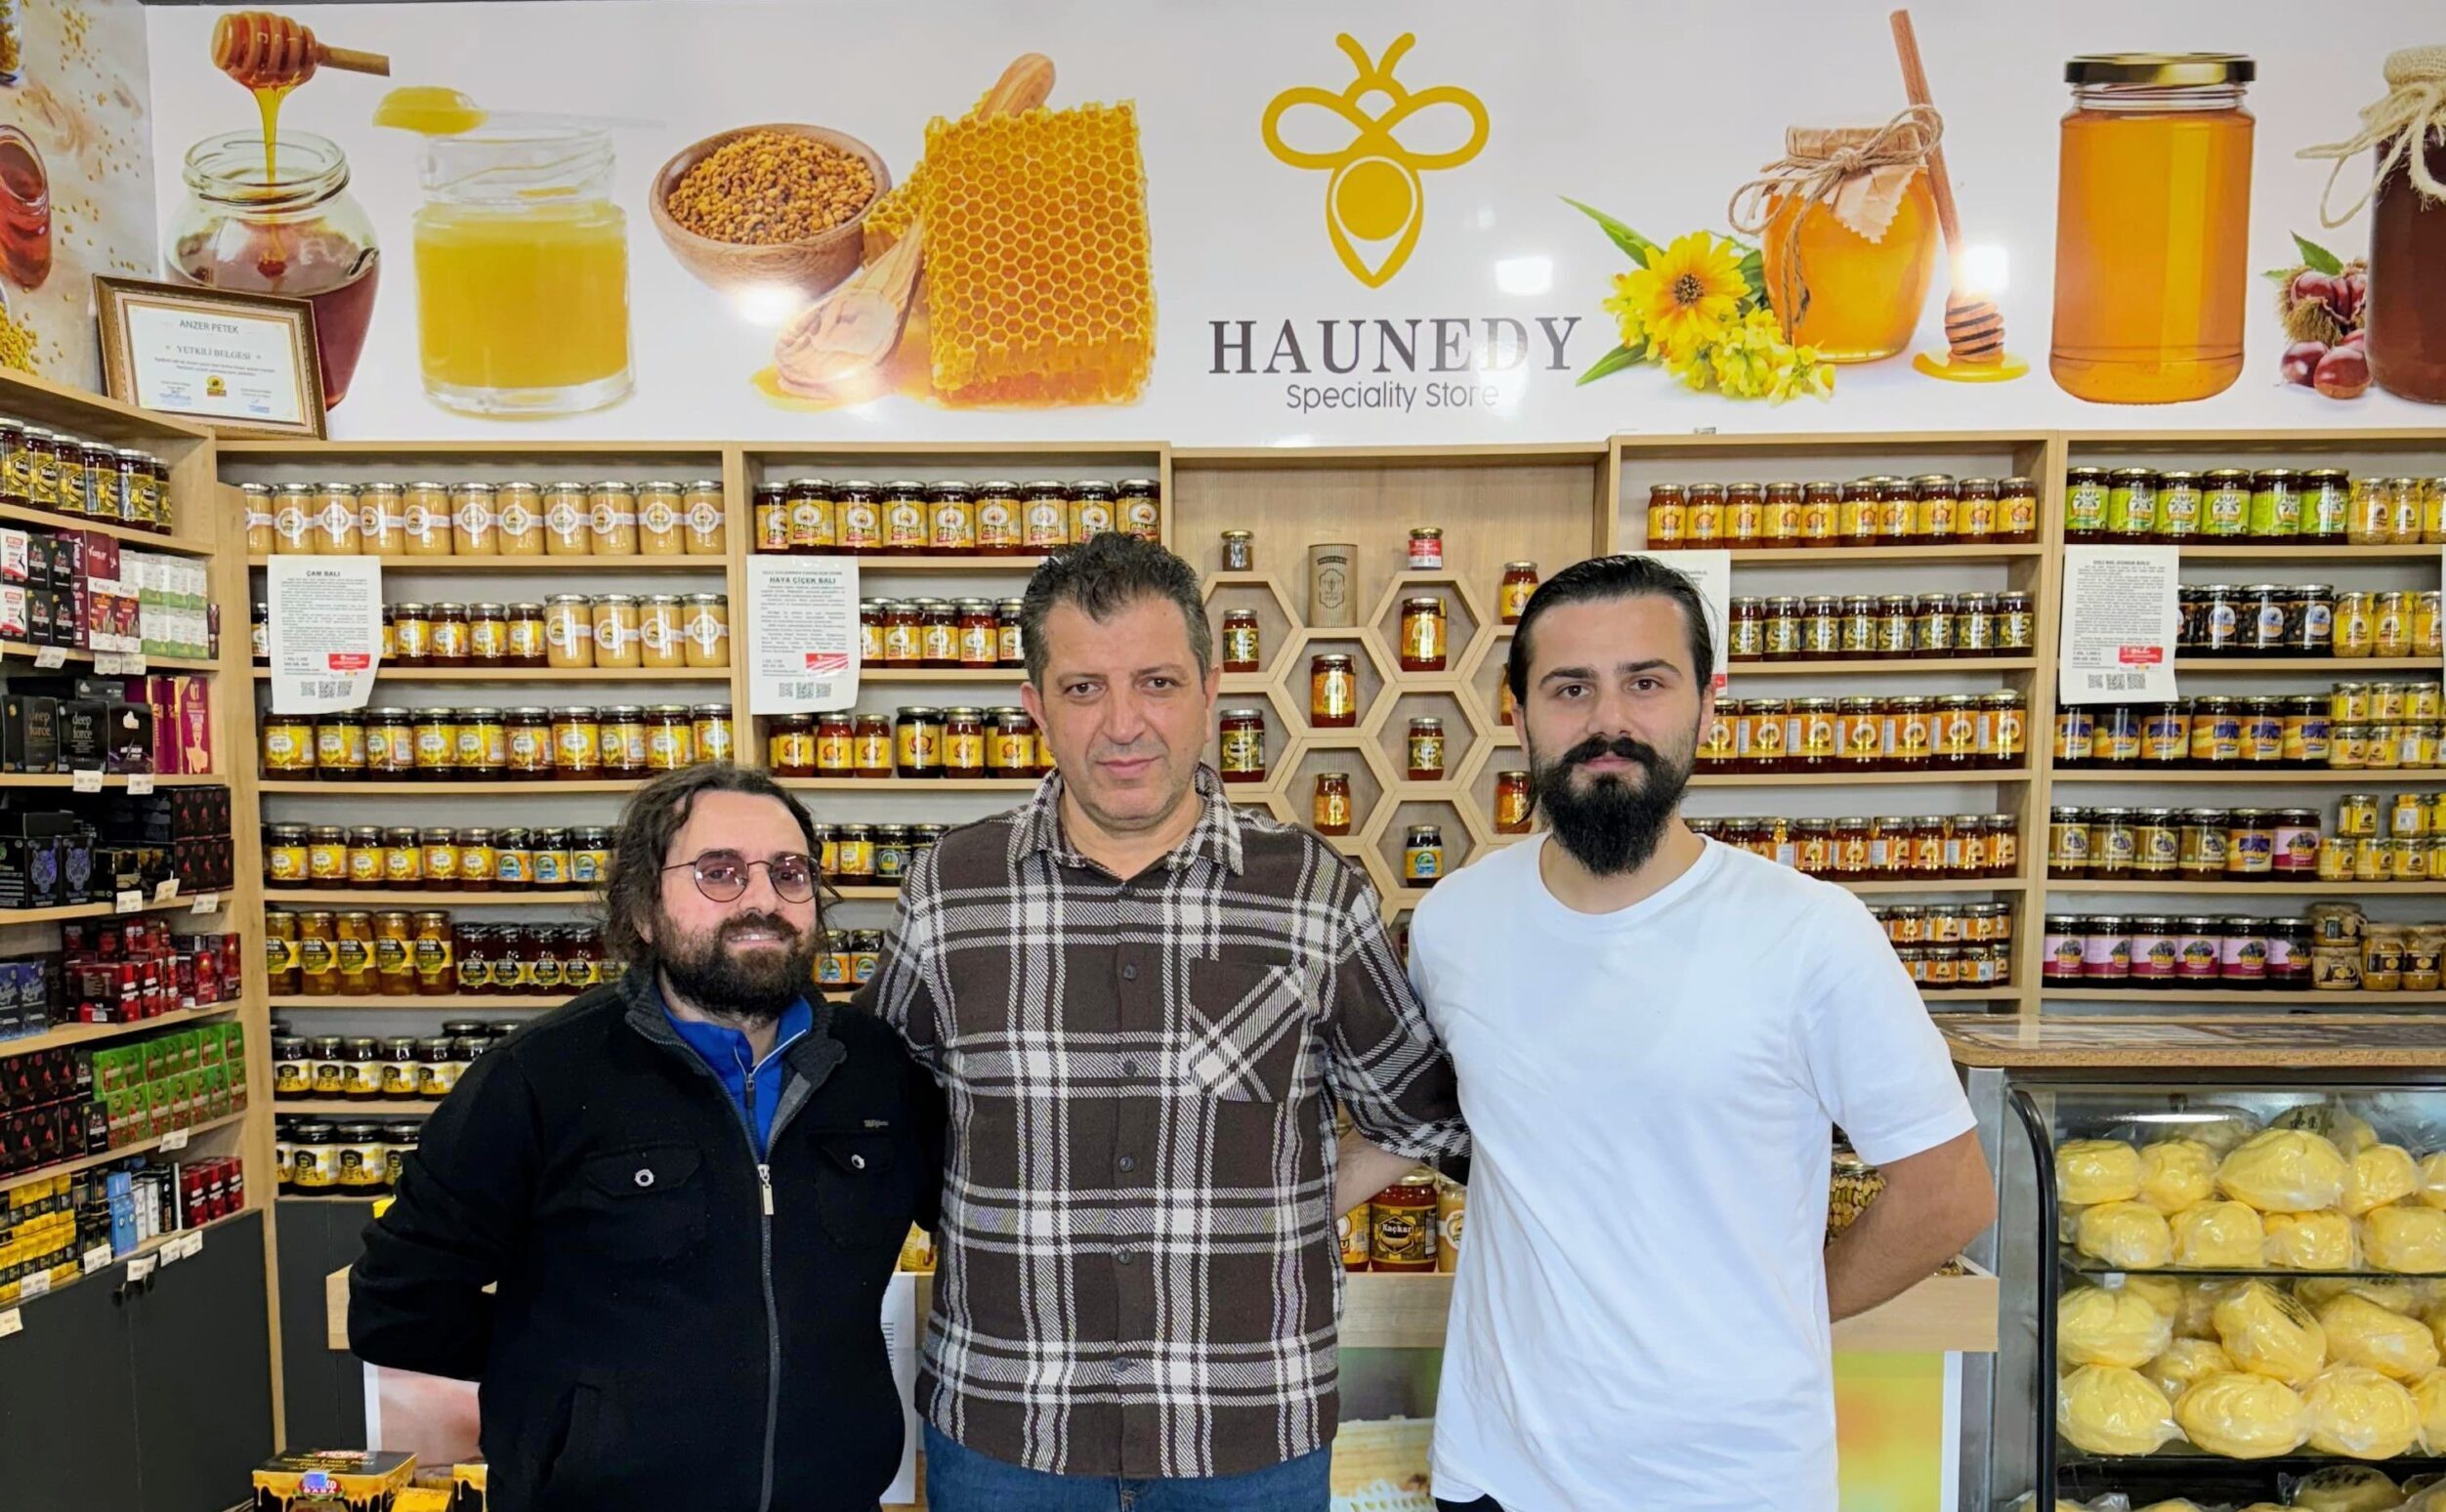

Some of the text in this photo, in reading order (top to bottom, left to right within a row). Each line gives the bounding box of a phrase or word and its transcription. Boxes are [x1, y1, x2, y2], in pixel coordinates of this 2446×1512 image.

[179, 319, 239, 334] ANZER PETEK
[1208, 316, 1582, 374] HAUNEDY
[1286, 381, 1499, 414] Speciality Store
[72, 711, 92, 729] deep
